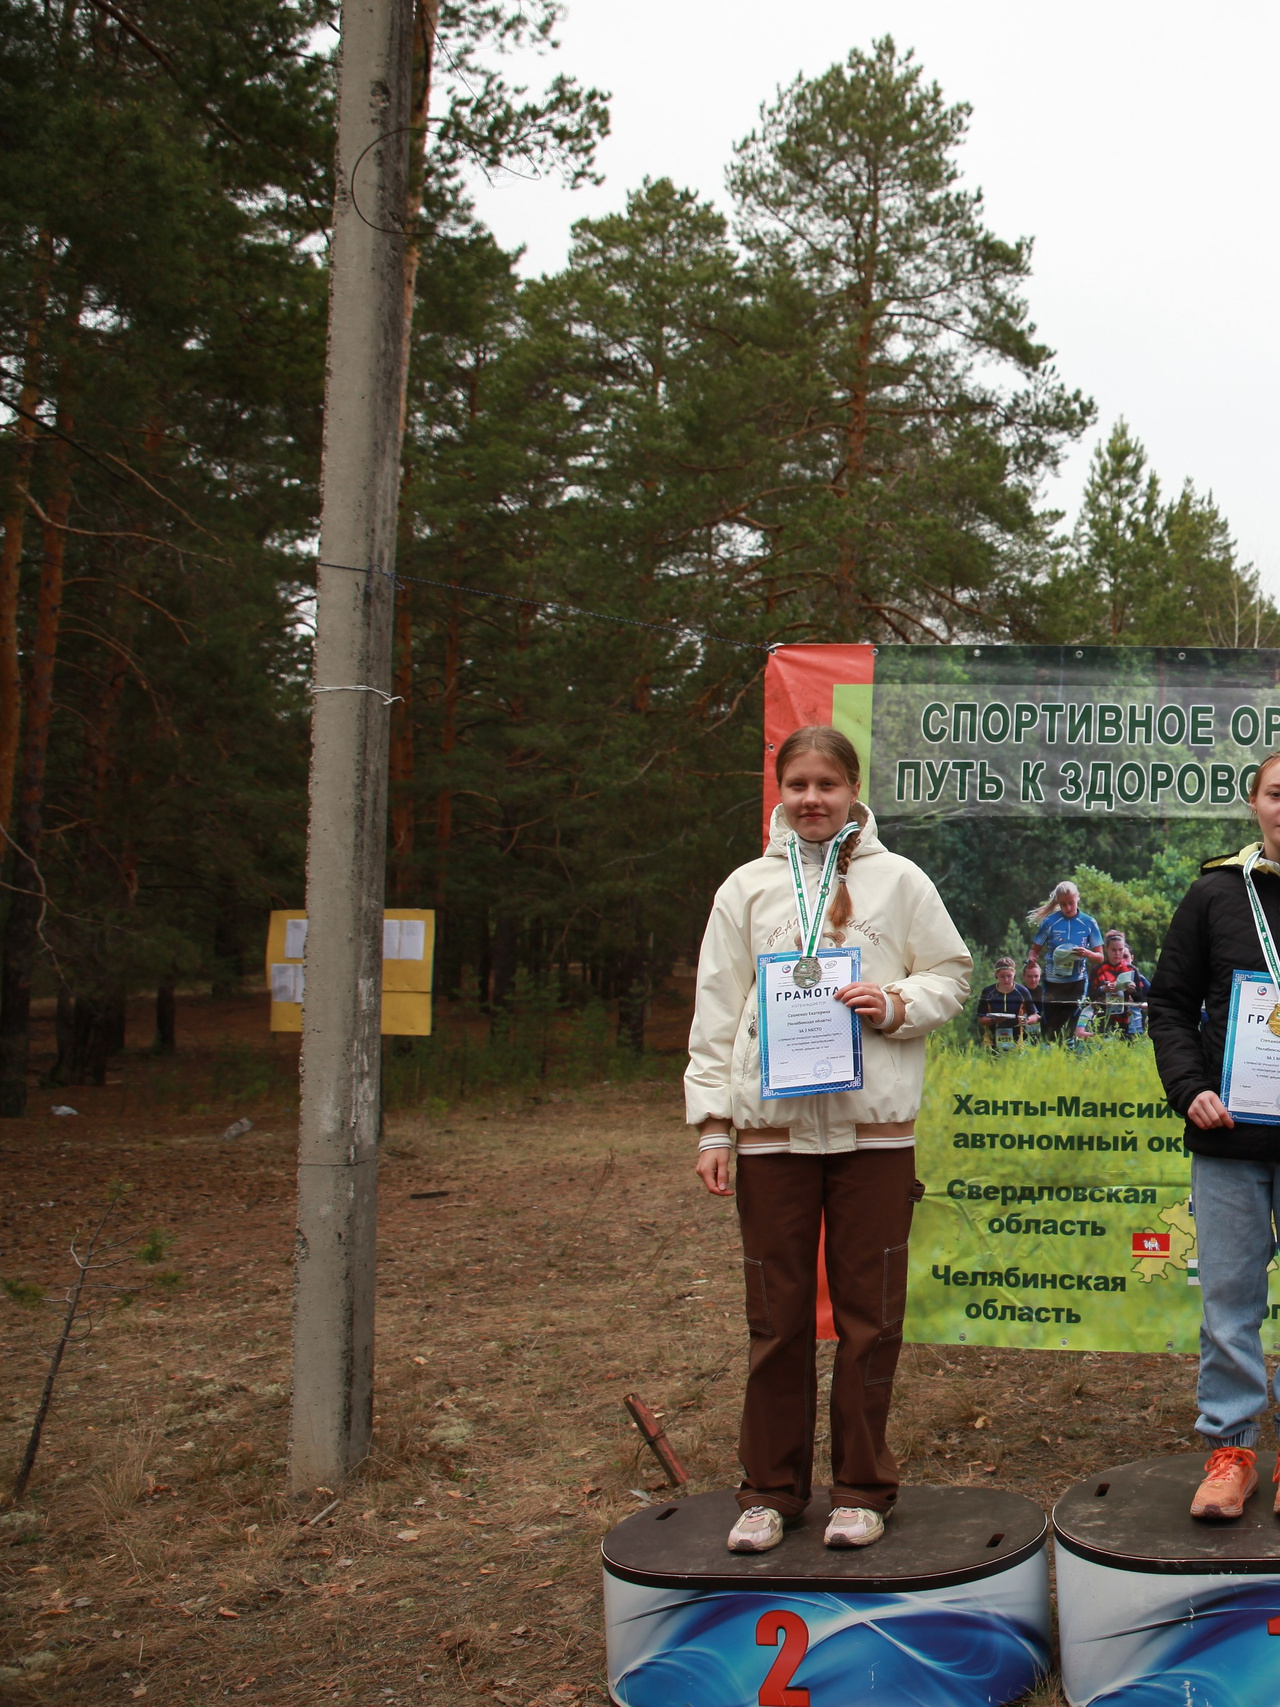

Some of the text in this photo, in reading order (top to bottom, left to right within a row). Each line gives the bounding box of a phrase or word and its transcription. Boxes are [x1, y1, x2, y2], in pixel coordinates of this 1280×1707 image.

[922, 702, 1215, 746] СПОРТИВНОЕ
[896, 760, 1005, 802] ПУТЬ
[1020, 761, 1046, 802] К
[776, 986, 839, 1002] ГРАМОТА
[953, 1130, 1138, 1153] автономный
[947, 1179, 1157, 1205] Свердловская
[988, 1213, 1107, 1237] область
[932, 1264, 1127, 1292] Челябинская
[965, 1299, 1081, 1324] область
[755, 1609, 810, 1707] 2
